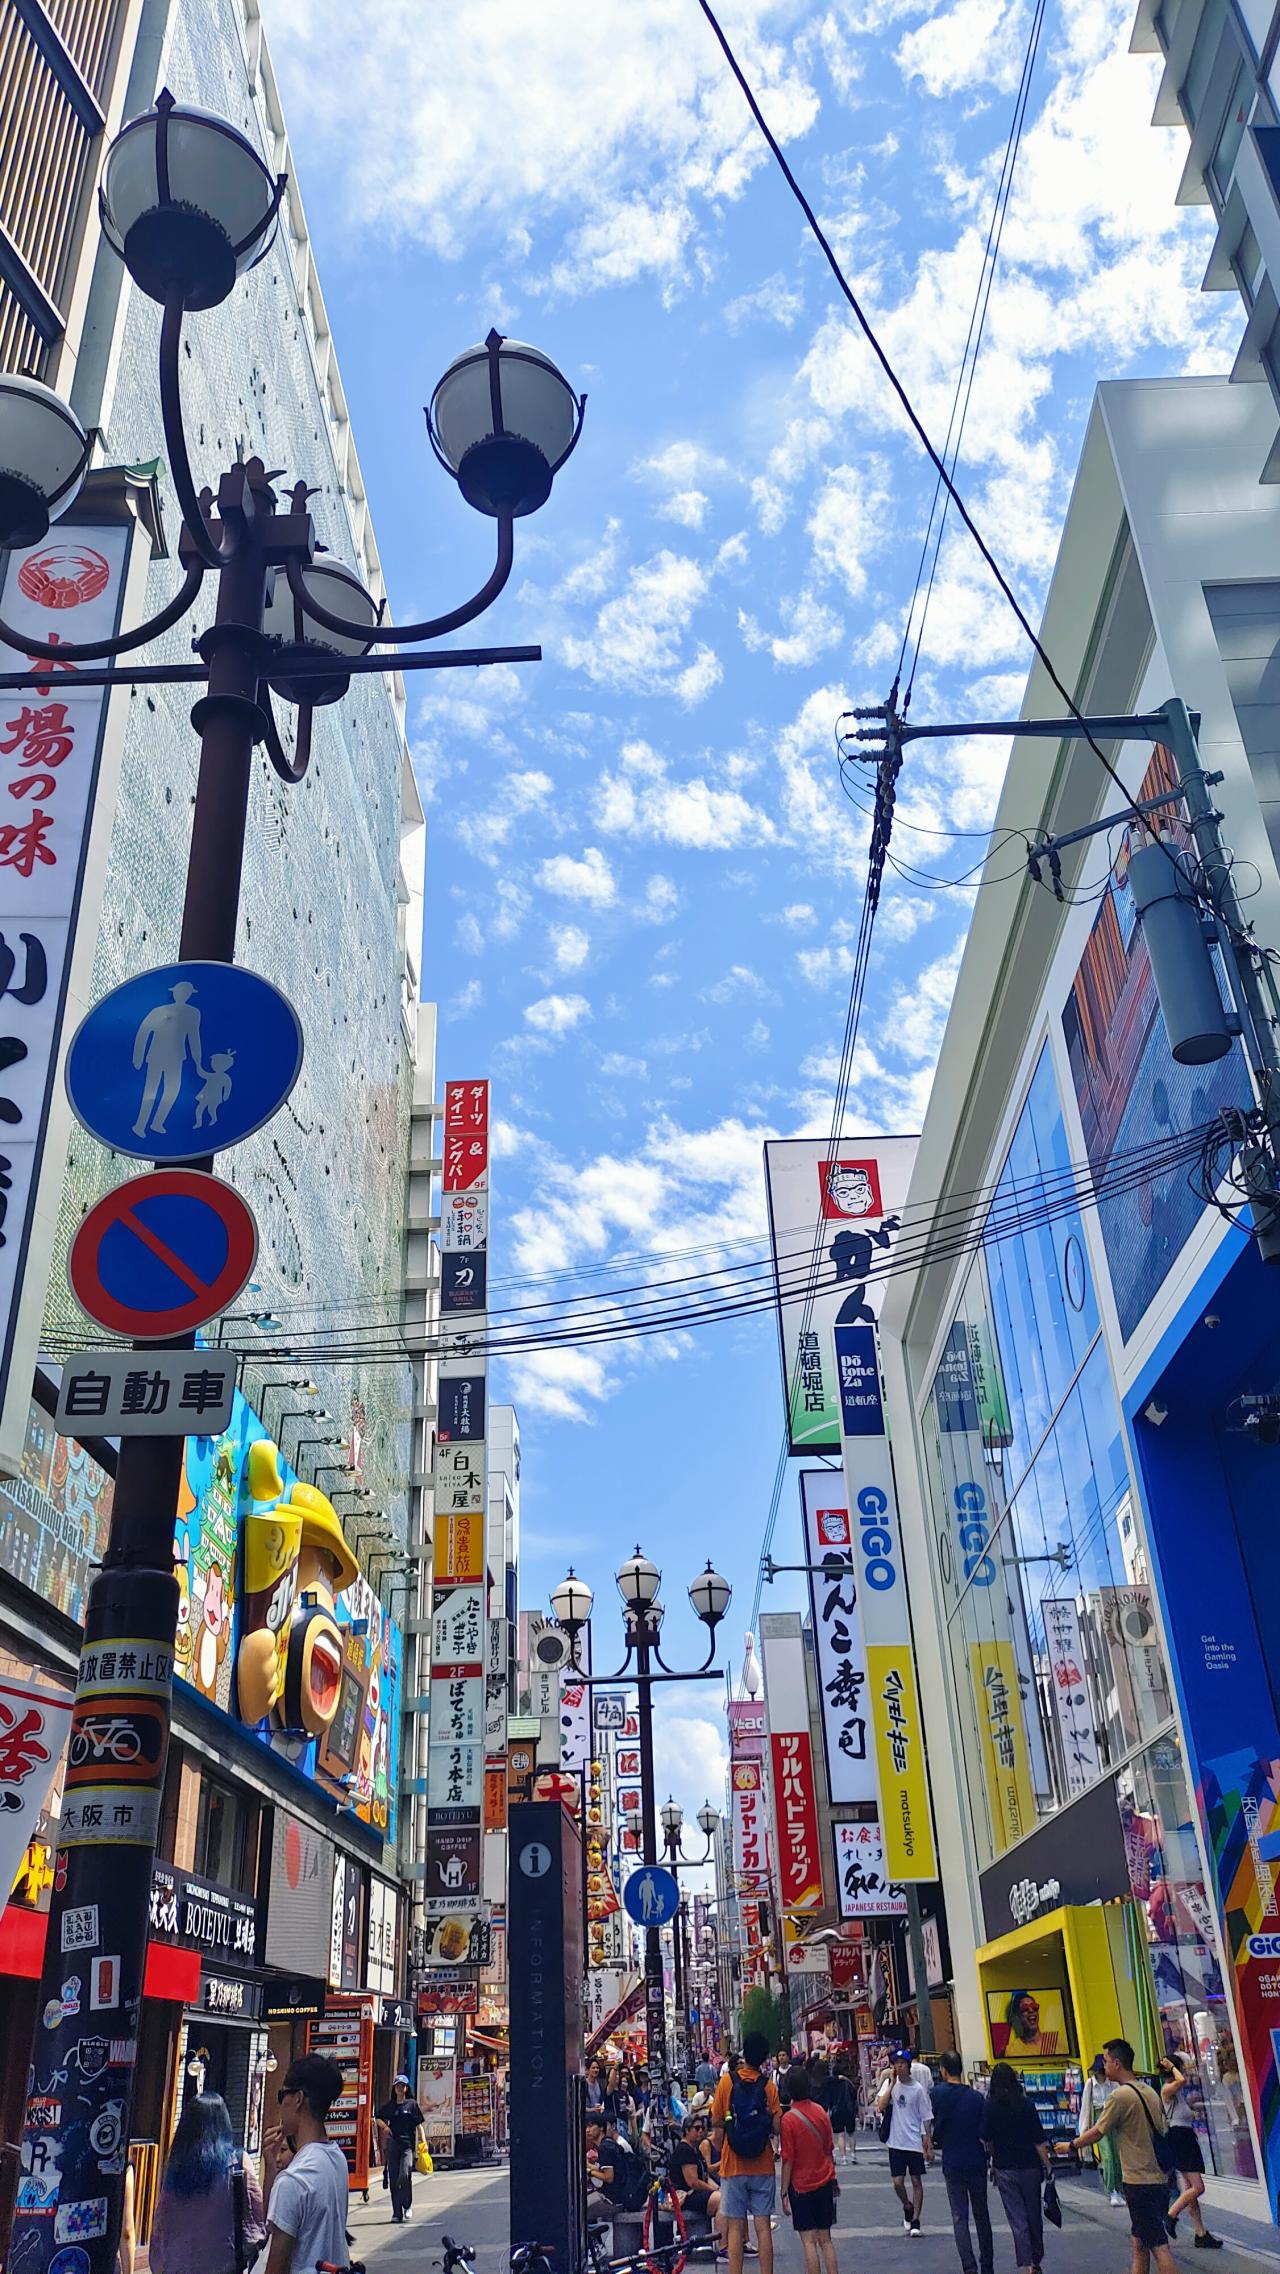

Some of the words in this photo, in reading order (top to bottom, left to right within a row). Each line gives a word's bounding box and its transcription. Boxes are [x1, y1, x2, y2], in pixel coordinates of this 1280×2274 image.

[448, 1086, 464, 1191] ダイニングバー
[474, 1181, 486, 1189] 9F
[459, 1255, 470, 1264] 7F
[799, 1331, 825, 1412] 道頓堀店
[841, 1366, 875, 1377] tone
[842, 1376, 863, 1388] Za
[64, 1370, 226, 1417] 自動車
[439, 1449, 451, 1458] 4F
[452, 1451, 481, 1508] 白木屋
[857, 1486, 897, 1591] GiGO
[457, 1518, 471, 1574] 鳥貴族
[434, 1593, 446, 1602] 3F
[466, 1596, 480, 1655] たこやき
[1201, 1635, 1216, 1643] Get
[1221, 1643, 1235, 1651] the
[1205, 1653, 1237, 1662] Gaming
[449, 1666, 465, 1678] 2F
[1206, 1662, 1229, 1670] Oasis
[883, 1669, 908, 1777] マツモトキヨシ
[446, 1679, 467, 1803] ぼてぢゅう本店
[780, 1736, 811, 1885] ツルハドラッグ
[61, 1804, 135, 1832] 大阪市
[434, 1812, 474, 1822] BOTEJYU
[898, 1790, 914, 1857] matsukiyo
[468, 1882, 477, 1893] 1F
[844, 1903, 875, 1912] JAPANESE
[184, 1901, 231, 1948] BOTEJYU
[832, 1947, 861, 1958] ツルハ
[834, 1958, 856, 1966] ドラッグ
[529, 1907, 543, 2090] INFORMATION
